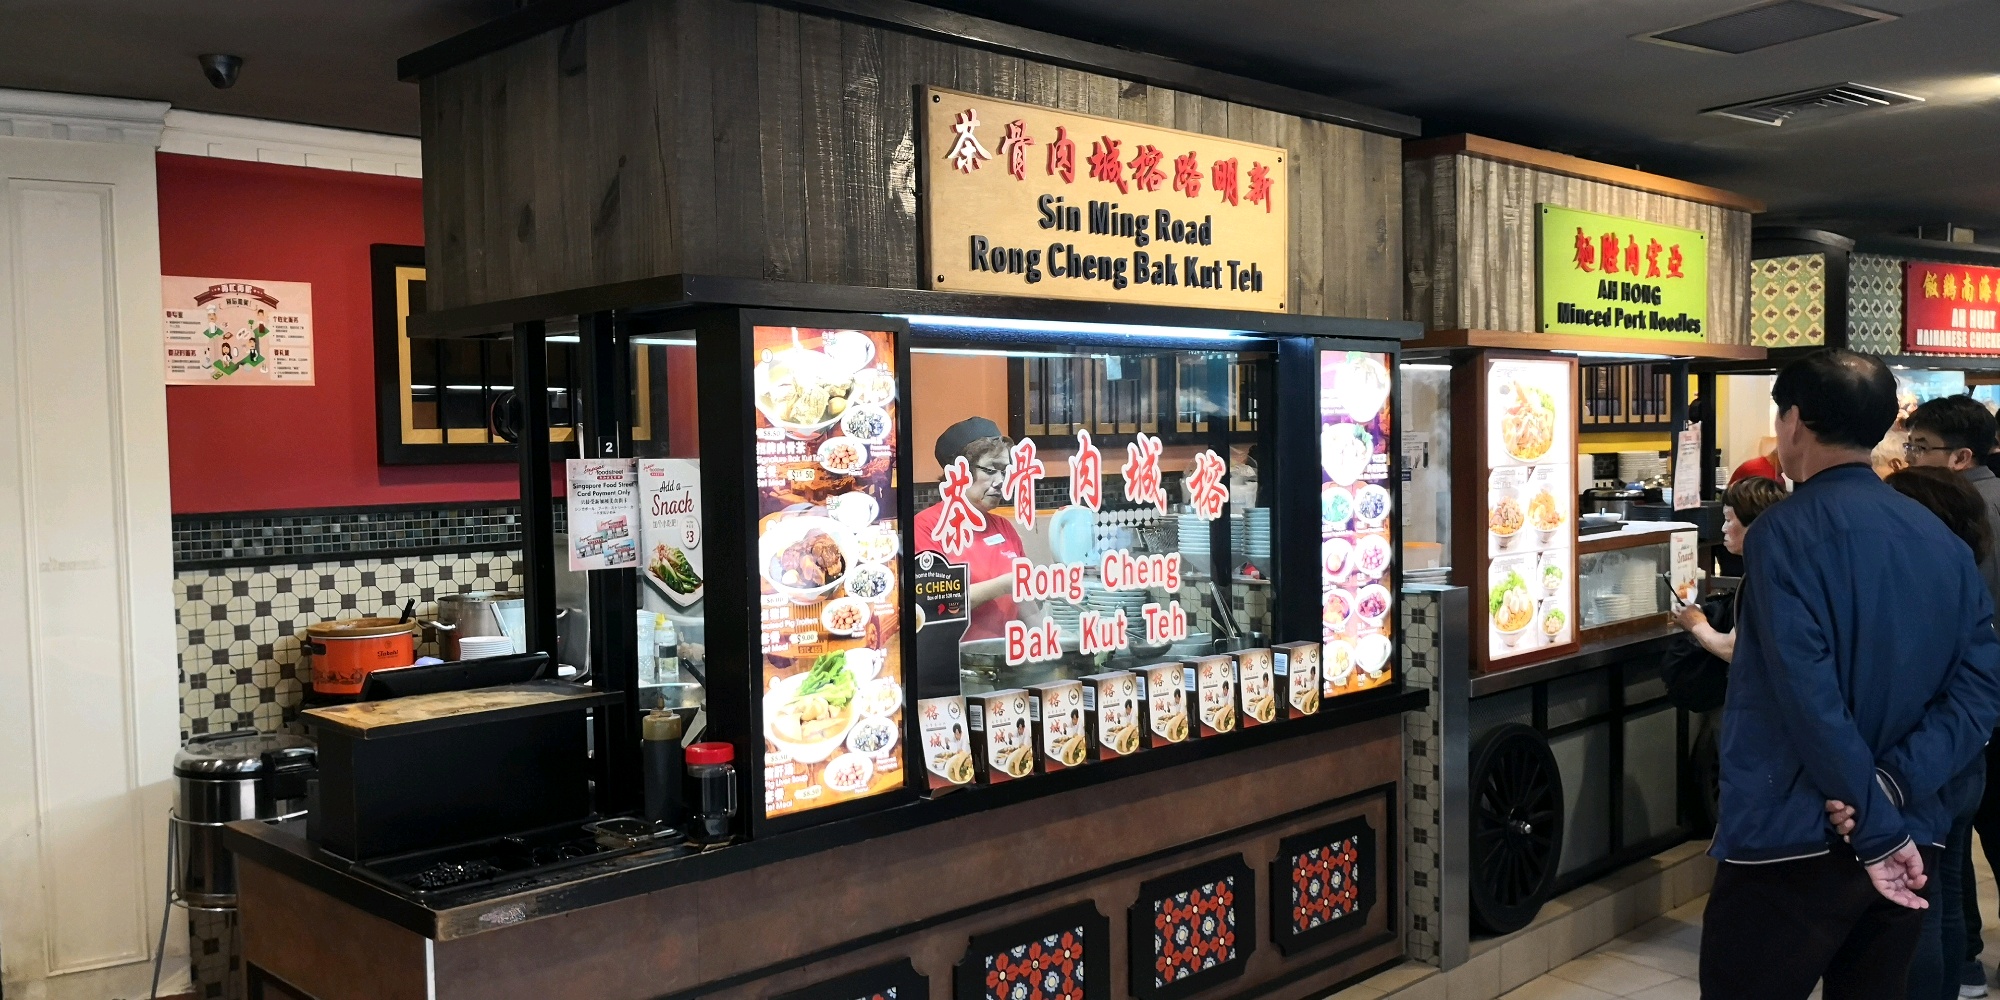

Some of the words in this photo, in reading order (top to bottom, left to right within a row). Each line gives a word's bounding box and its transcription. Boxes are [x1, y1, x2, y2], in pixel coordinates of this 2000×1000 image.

[1037, 193, 1081, 232] Sin
[1088, 200, 1149, 247] Ming
[1155, 208, 1212, 246] Road
[969, 234, 1041, 284] Rong
[1047, 242, 1128, 290] Cheng
[1133, 250, 1178, 286] Bak
[1184, 255, 1222, 290] Kut
[1227, 259, 1263, 292] Teh
[1597, 279, 1618, 302] AH
[1621, 282, 1662, 306] HONG
[1557, 302, 1612, 328] Minced
[1615, 307, 1647, 330] Pork
[1649, 310, 1701, 334] Noodles
[1951, 308, 1967, 328] AH
[1969, 309, 1996, 330] HUAT
[1916, 329, 1968, 347] HAINANESE
[605, 442, 613, 453] 2
[659, 480, 674, 492] Add
[676, 482, 681, 491] a
[652, 490, 695, 517] Snack
[686, 530, 695, 543] $3
[925, 579, 961, 594] CHENG
[1015, 562, 1082, 600] Rong
[1103, 552, 1178, 589] Cheng
[1008, 621, 1059, 661] Bak
[1082, 614, 1126, 650] Kut
[1145, 604, 1184, 640] Teh
